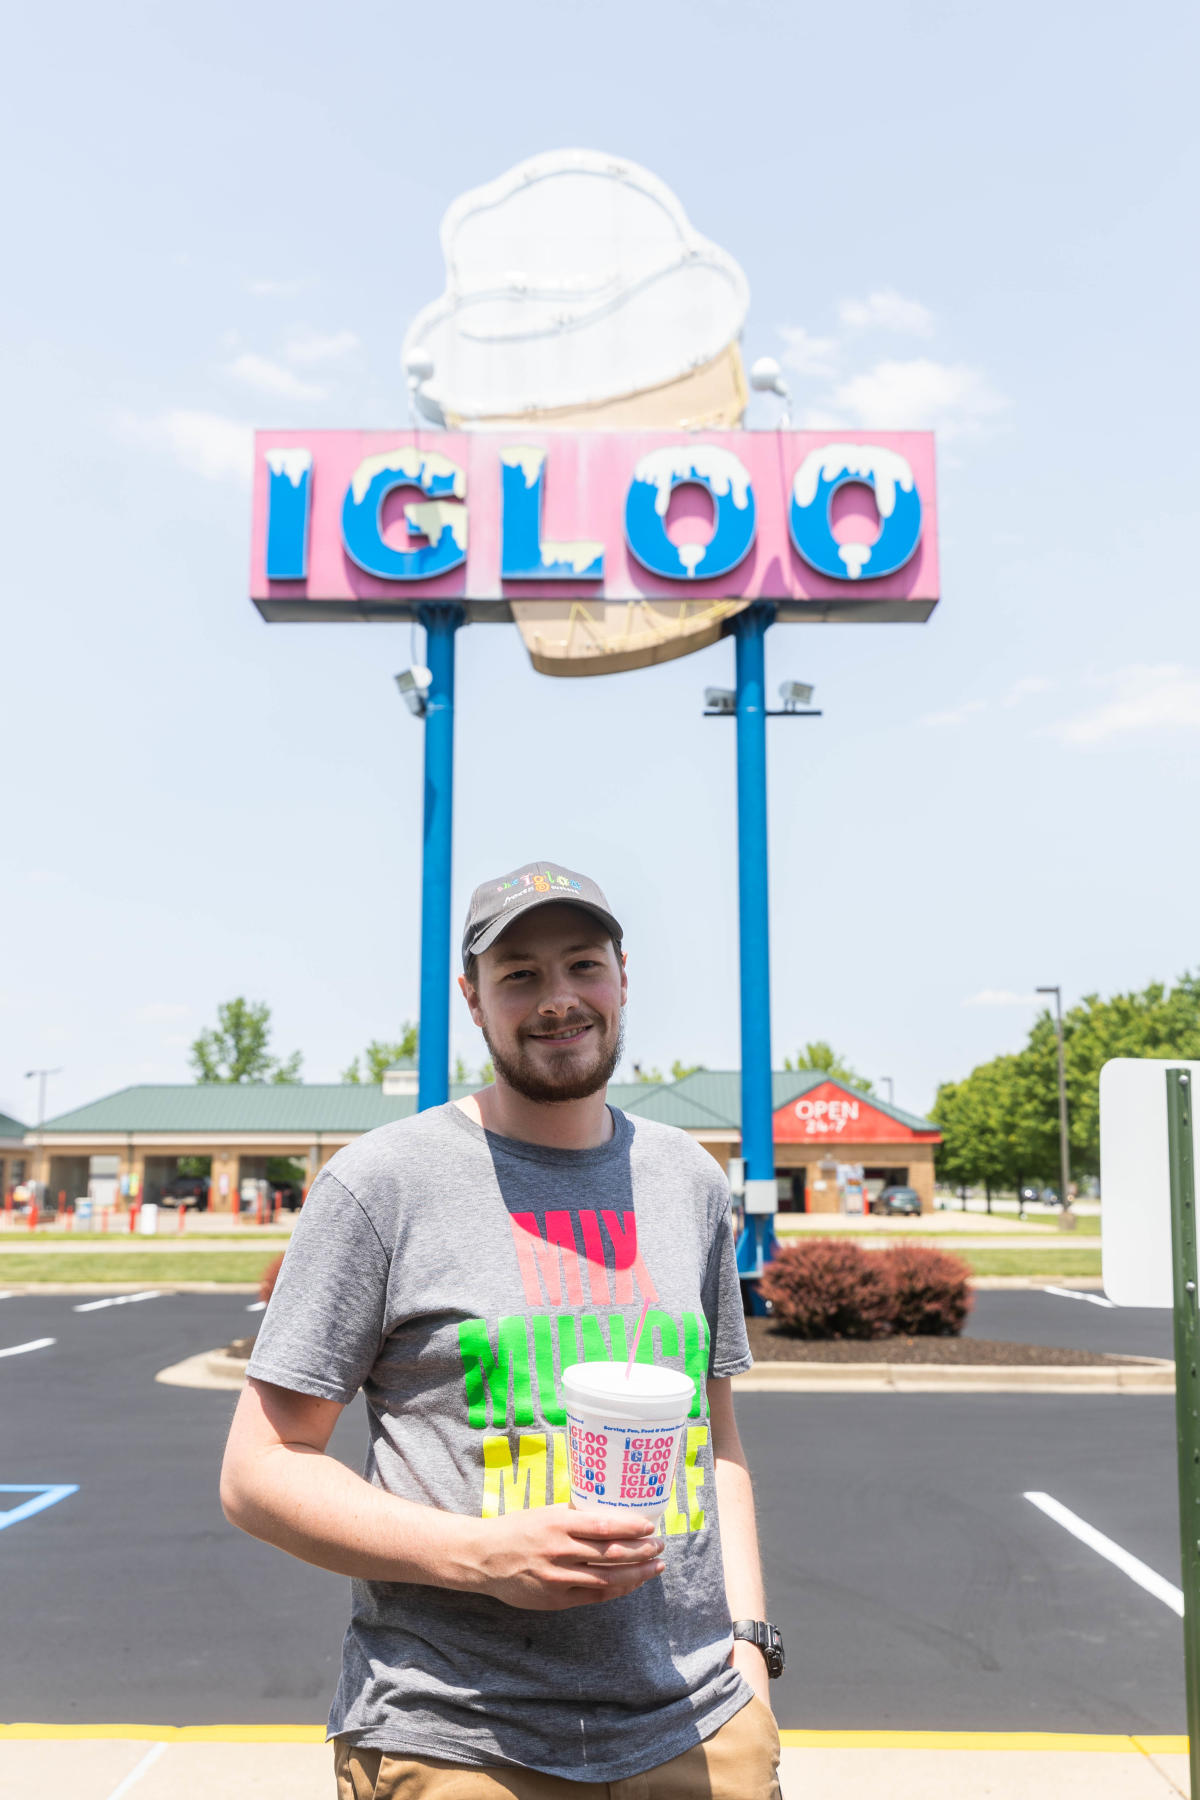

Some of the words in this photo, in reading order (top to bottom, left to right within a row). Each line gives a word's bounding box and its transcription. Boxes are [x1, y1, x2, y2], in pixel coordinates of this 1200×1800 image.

[265, 444, 922, 581] IGLOO
[795, 1100, 859, 1120] OPEN
[508, 1209, 660, 1307] MIX
[625, 1436, 674, 1450] IGLOO
[623, 1448, 671, 1462] IGLOO
[622, 1460, 669, 1474] IGLOO
[620, 1472, 666, 1486] IGLOO
[619, 1484, 664, 1498] IGLOO
